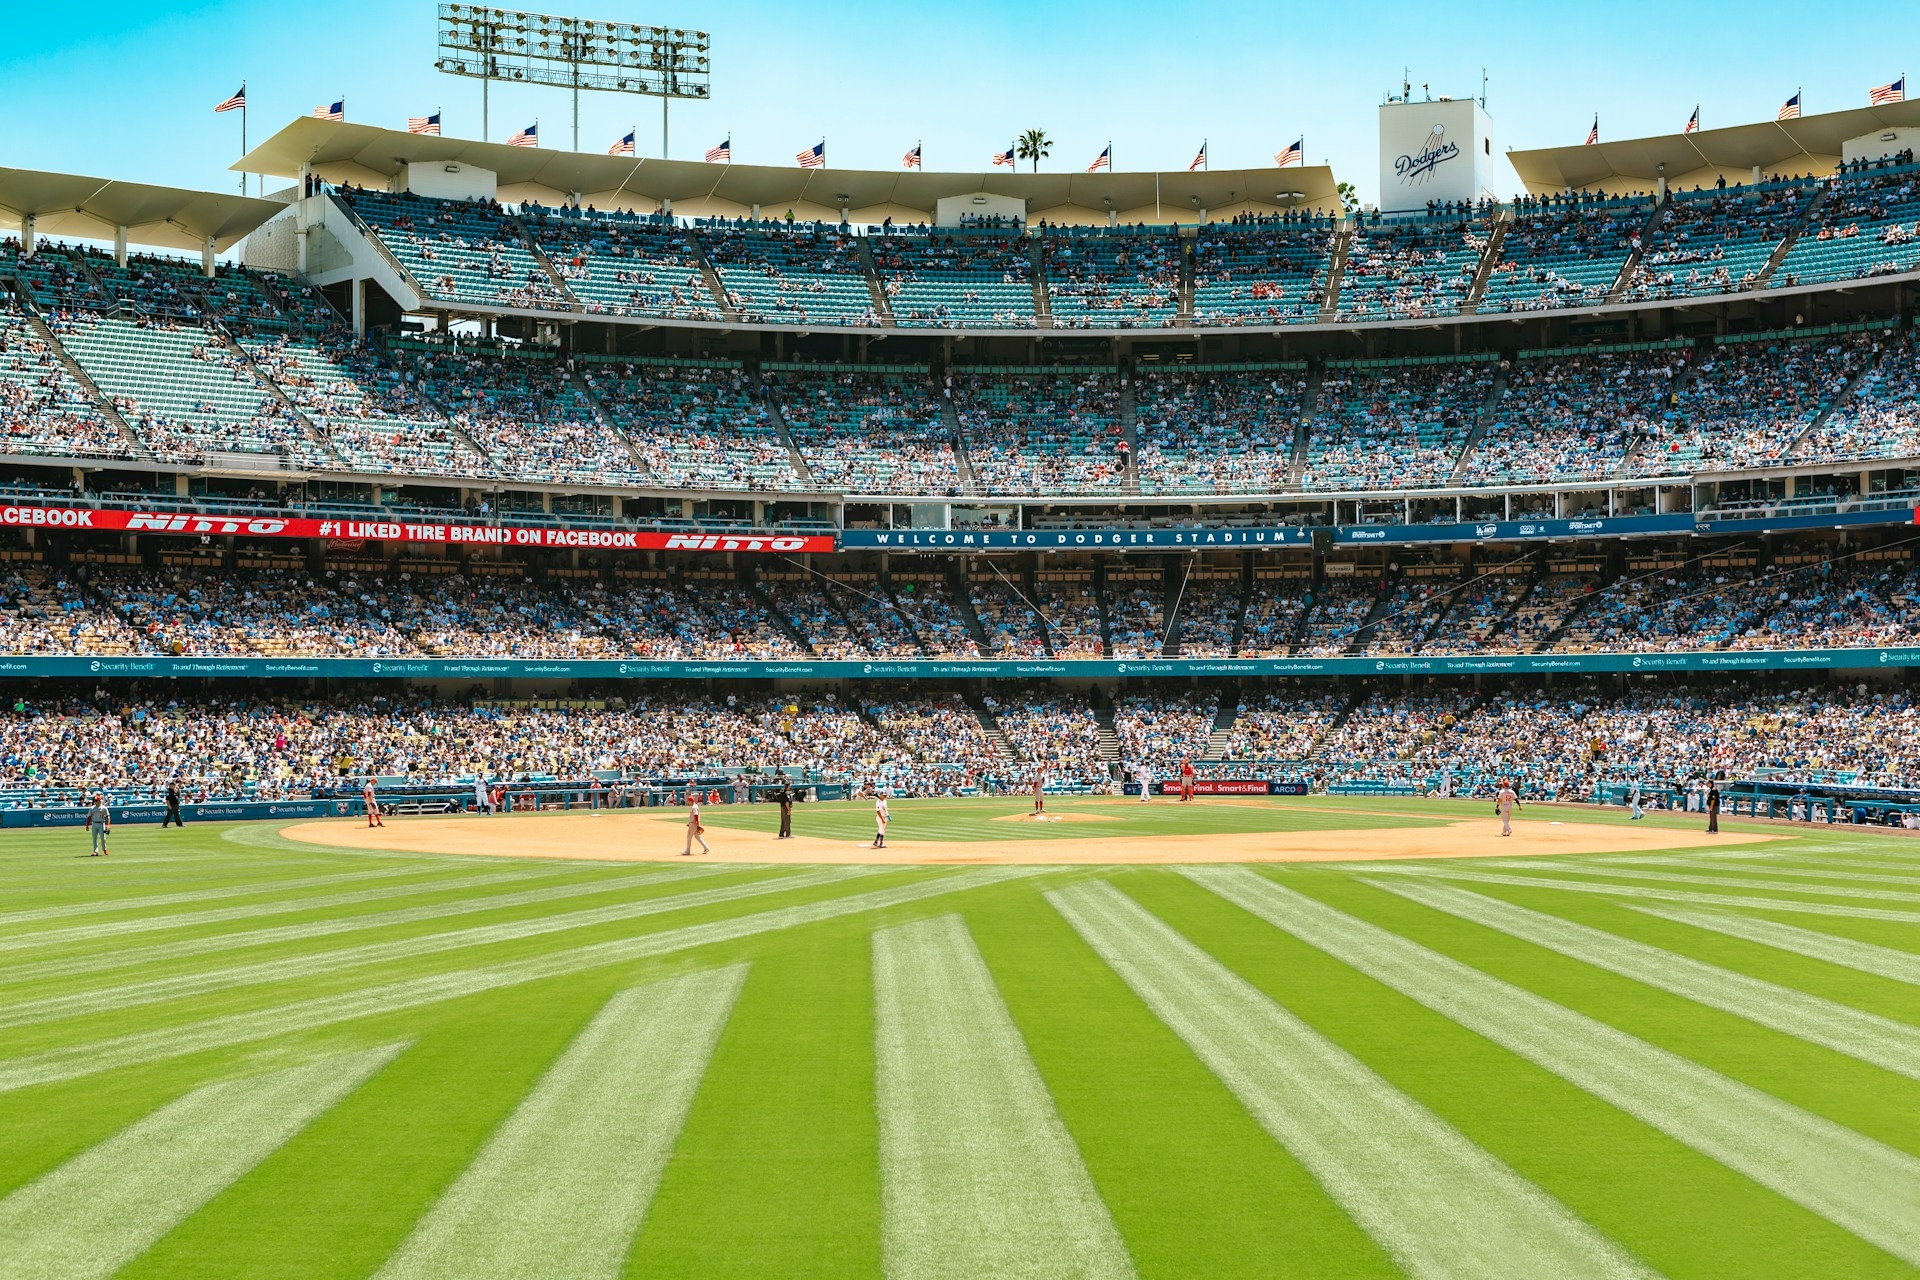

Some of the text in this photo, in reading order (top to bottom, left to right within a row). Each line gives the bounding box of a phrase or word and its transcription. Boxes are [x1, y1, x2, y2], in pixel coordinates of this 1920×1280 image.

[1395, 141, 1460, 177] Dodgers
[0, 507, 93, 526] CEBOOK
[126, 513, 286, 534] NITTO
[319, 521, 638, 547] #1 LIKED TIRE BRAND ON FACEBOOK
[876, 532, 1285, 544] WELCOME TO DODGER STADIUM
[665, 534, 805, 550] NITTO
[1385, 661, 1431, 670] Security Benefit
[1642, 658, 1665, 666] Security
[101, 663, 129, 671] Security
[382, 664, 407, 672] Security
[628, 665, 650, 673] Security
[1163, 784, 1214, 792] SmaFinal.
[51, 812, 73, 820] Security
